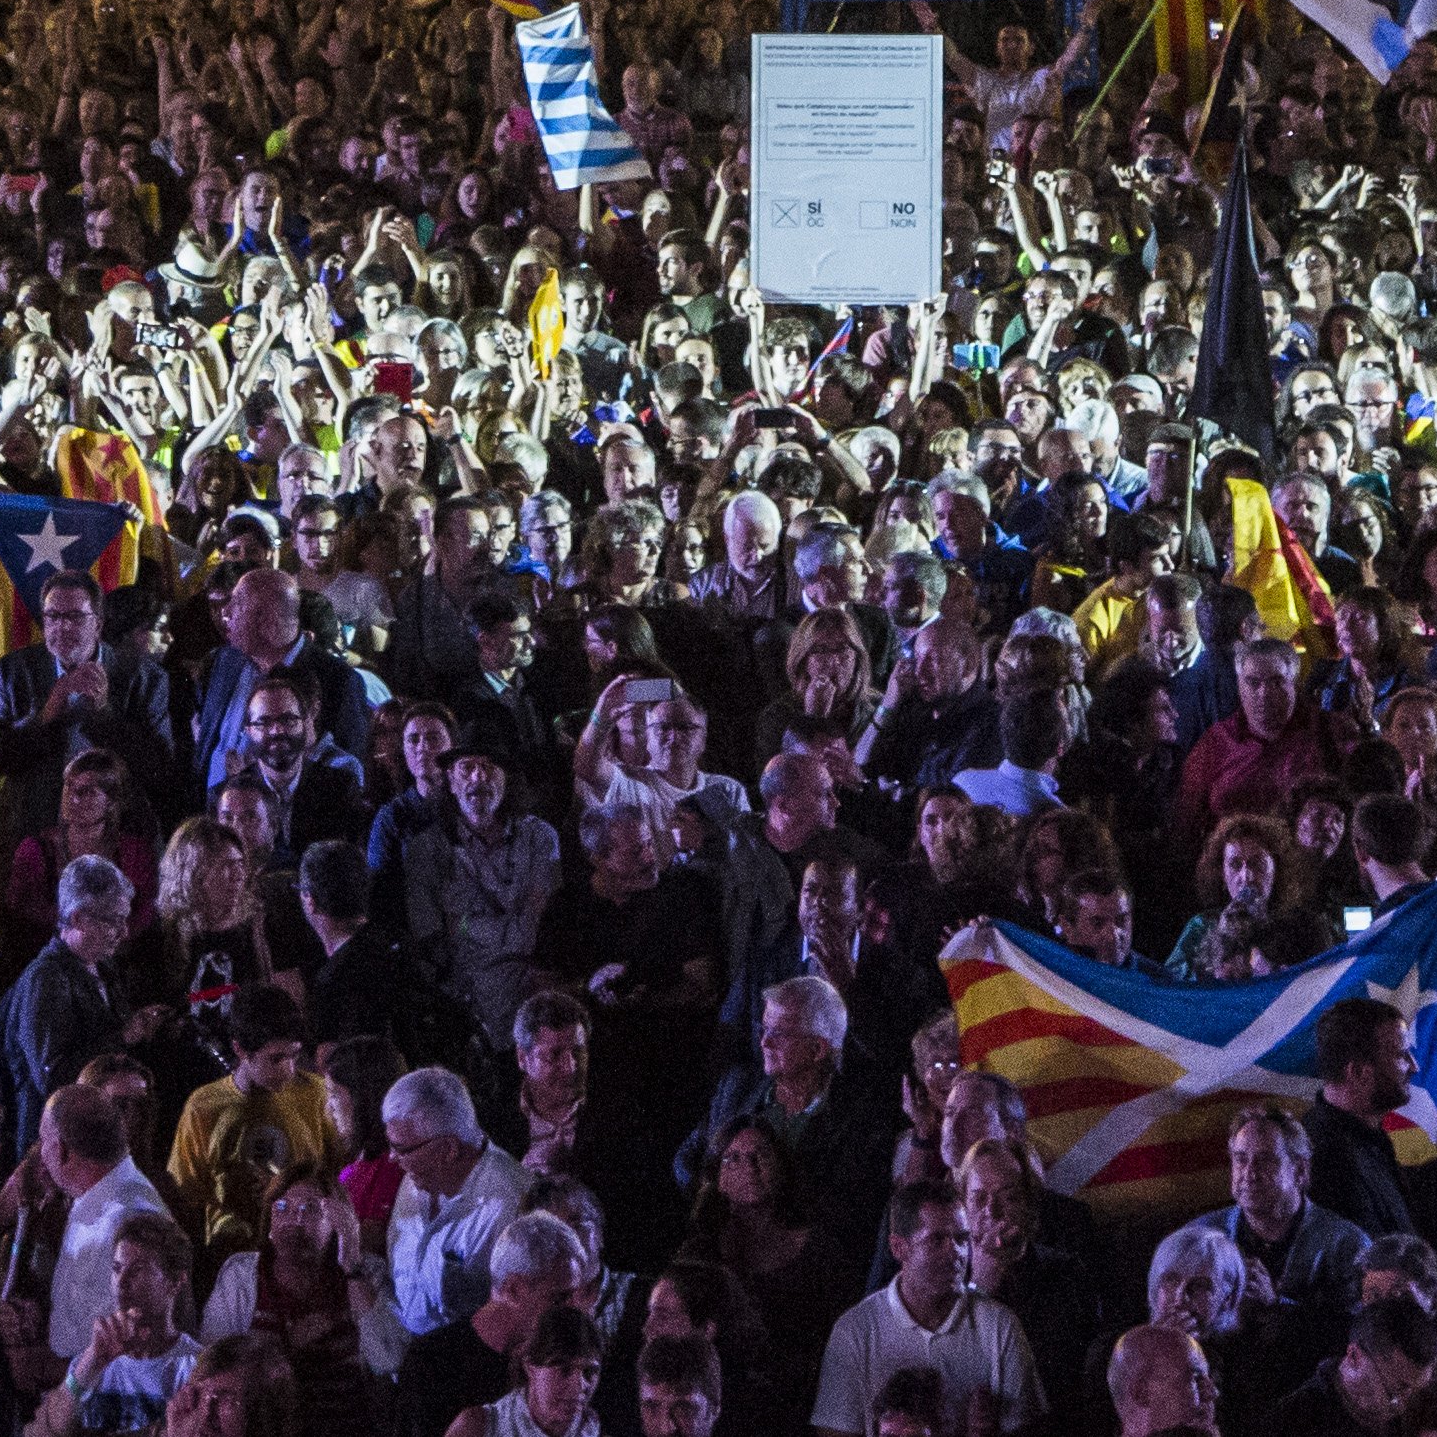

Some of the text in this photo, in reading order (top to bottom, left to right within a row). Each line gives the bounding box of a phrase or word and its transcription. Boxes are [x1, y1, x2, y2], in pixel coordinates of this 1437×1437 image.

[893, 202, 916, 215] NO
[807, 217, 824, 229] OC
[890, 218, 916, 228] NON
